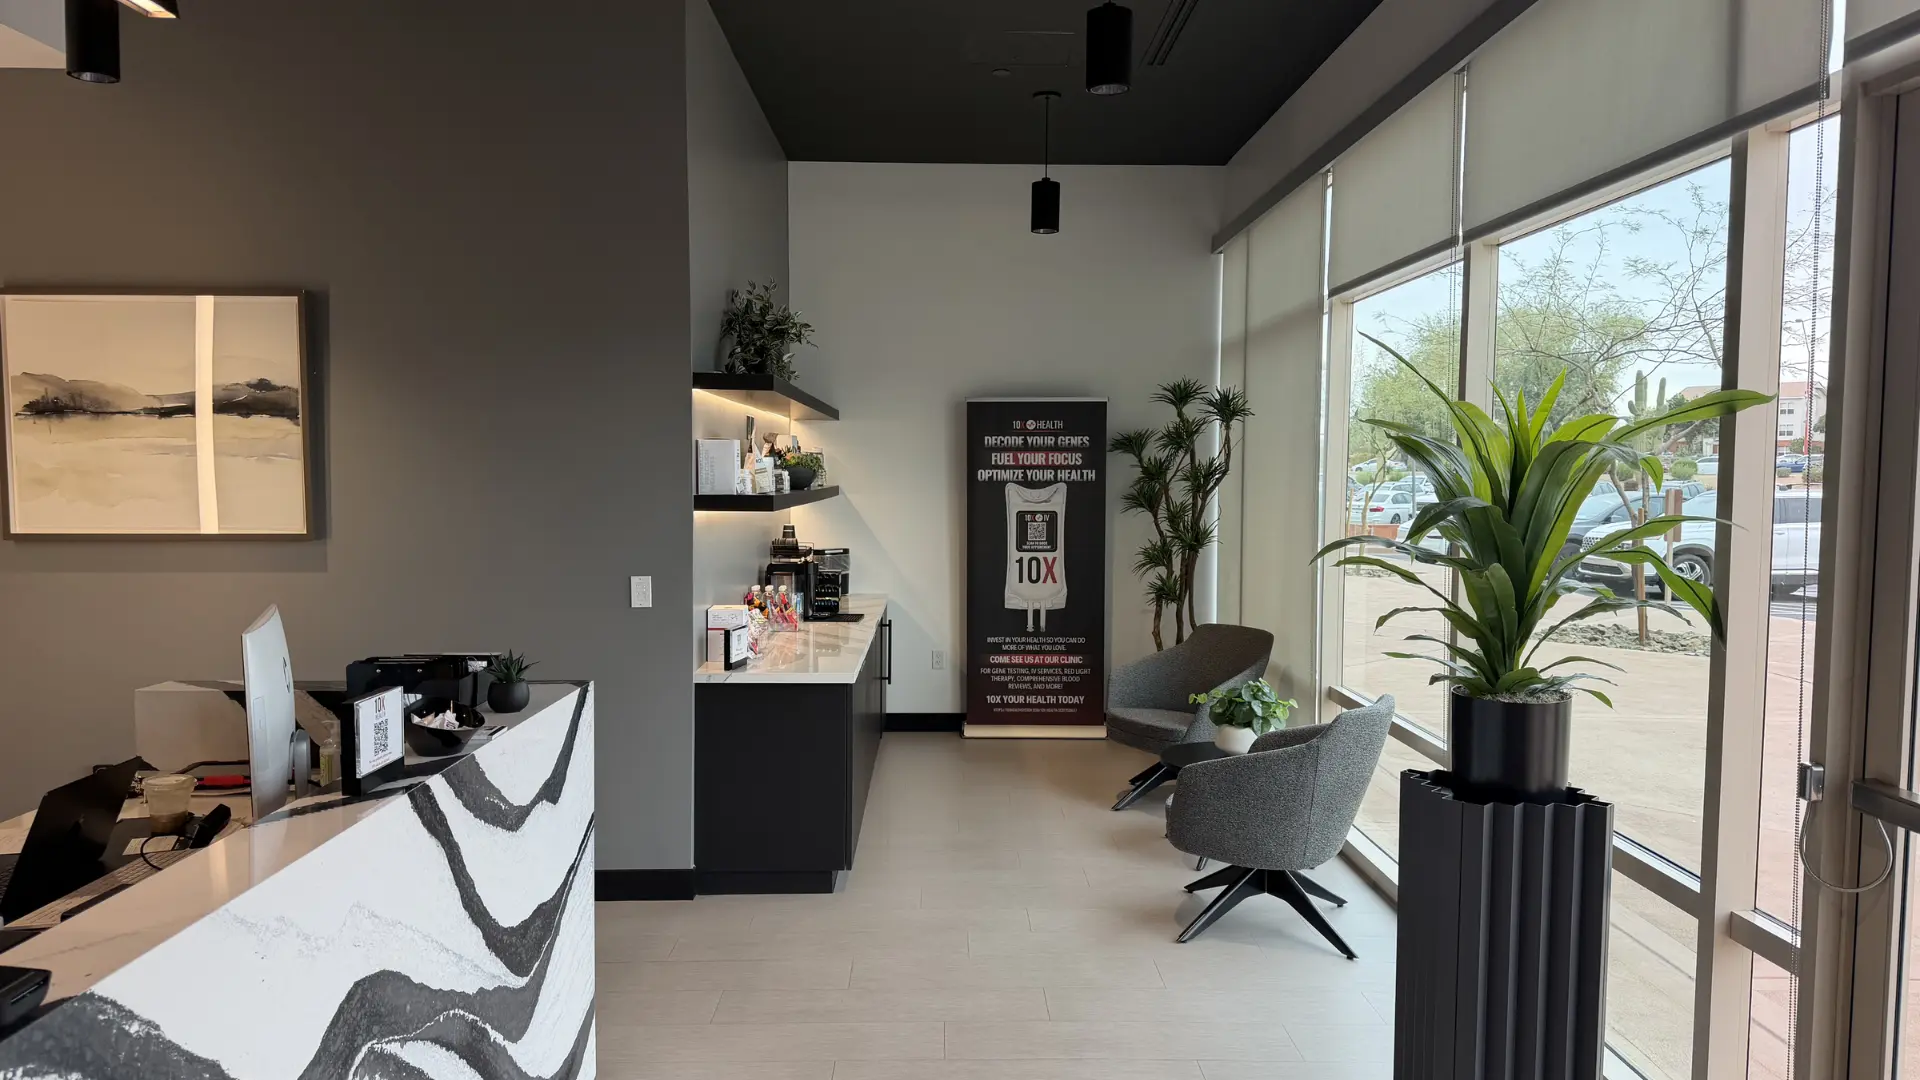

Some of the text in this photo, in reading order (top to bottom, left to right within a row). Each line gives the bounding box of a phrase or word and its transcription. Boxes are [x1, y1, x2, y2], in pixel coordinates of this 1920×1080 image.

[1013, 420, 1063, 429] 10X HEALTH
[984, 436, 1090, 448] DECODE YOUR GENES
[992, 453, 1082, 465] FUEL YOUR FOCUS
[977, 469, 1095, 481] OPTIMIZE YOUR HEALTH
[1016, 556, 1057, 584] 10X
[990, 656, 1083, 664] COME SEE US AT OUR CLINIC
[374, 695, 386, 713] 10X
